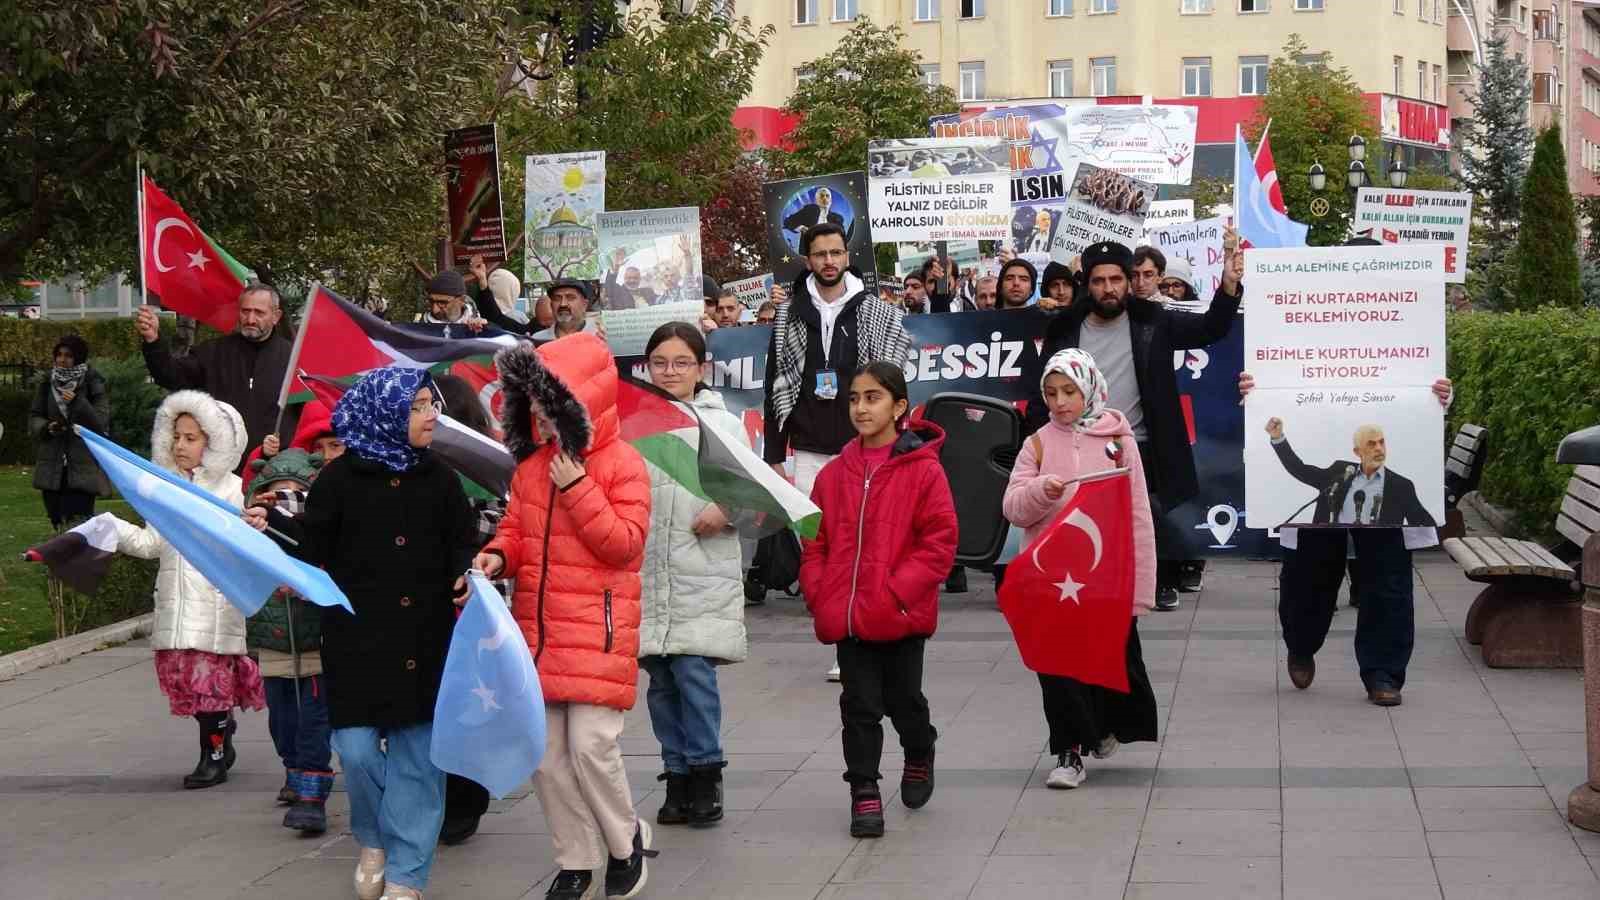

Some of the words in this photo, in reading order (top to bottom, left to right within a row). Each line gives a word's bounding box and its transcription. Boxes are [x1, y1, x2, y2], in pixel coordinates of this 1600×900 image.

[884, 181, 942, 197] FİLİSTİNLİ
[945, 180, 995, 194] ESİRLER
[887, 200, 930, 213] YALNIZ
[933, 197, 988, 211] DEĞİLDİR
[871, 215, 944, 228] KAHROLSUN
[1066, 223, 1090, 241] DESTEK
[1295, 260, 1349, 273] ALEMİNE
[1352, 258, 1433, 275] ÇAĞRIMIZDİR
[1307, 290, 1418, 305] KURTARMANIZI
[1285, 307, 1405, 323] BEKLEMİYORUZ.
[902, 331, 1024, 382] SESSİZ
[1256, 346, 1314, 361] BİZİMLE
[1318, 346, 1430, 361] KURTULMANIZI
